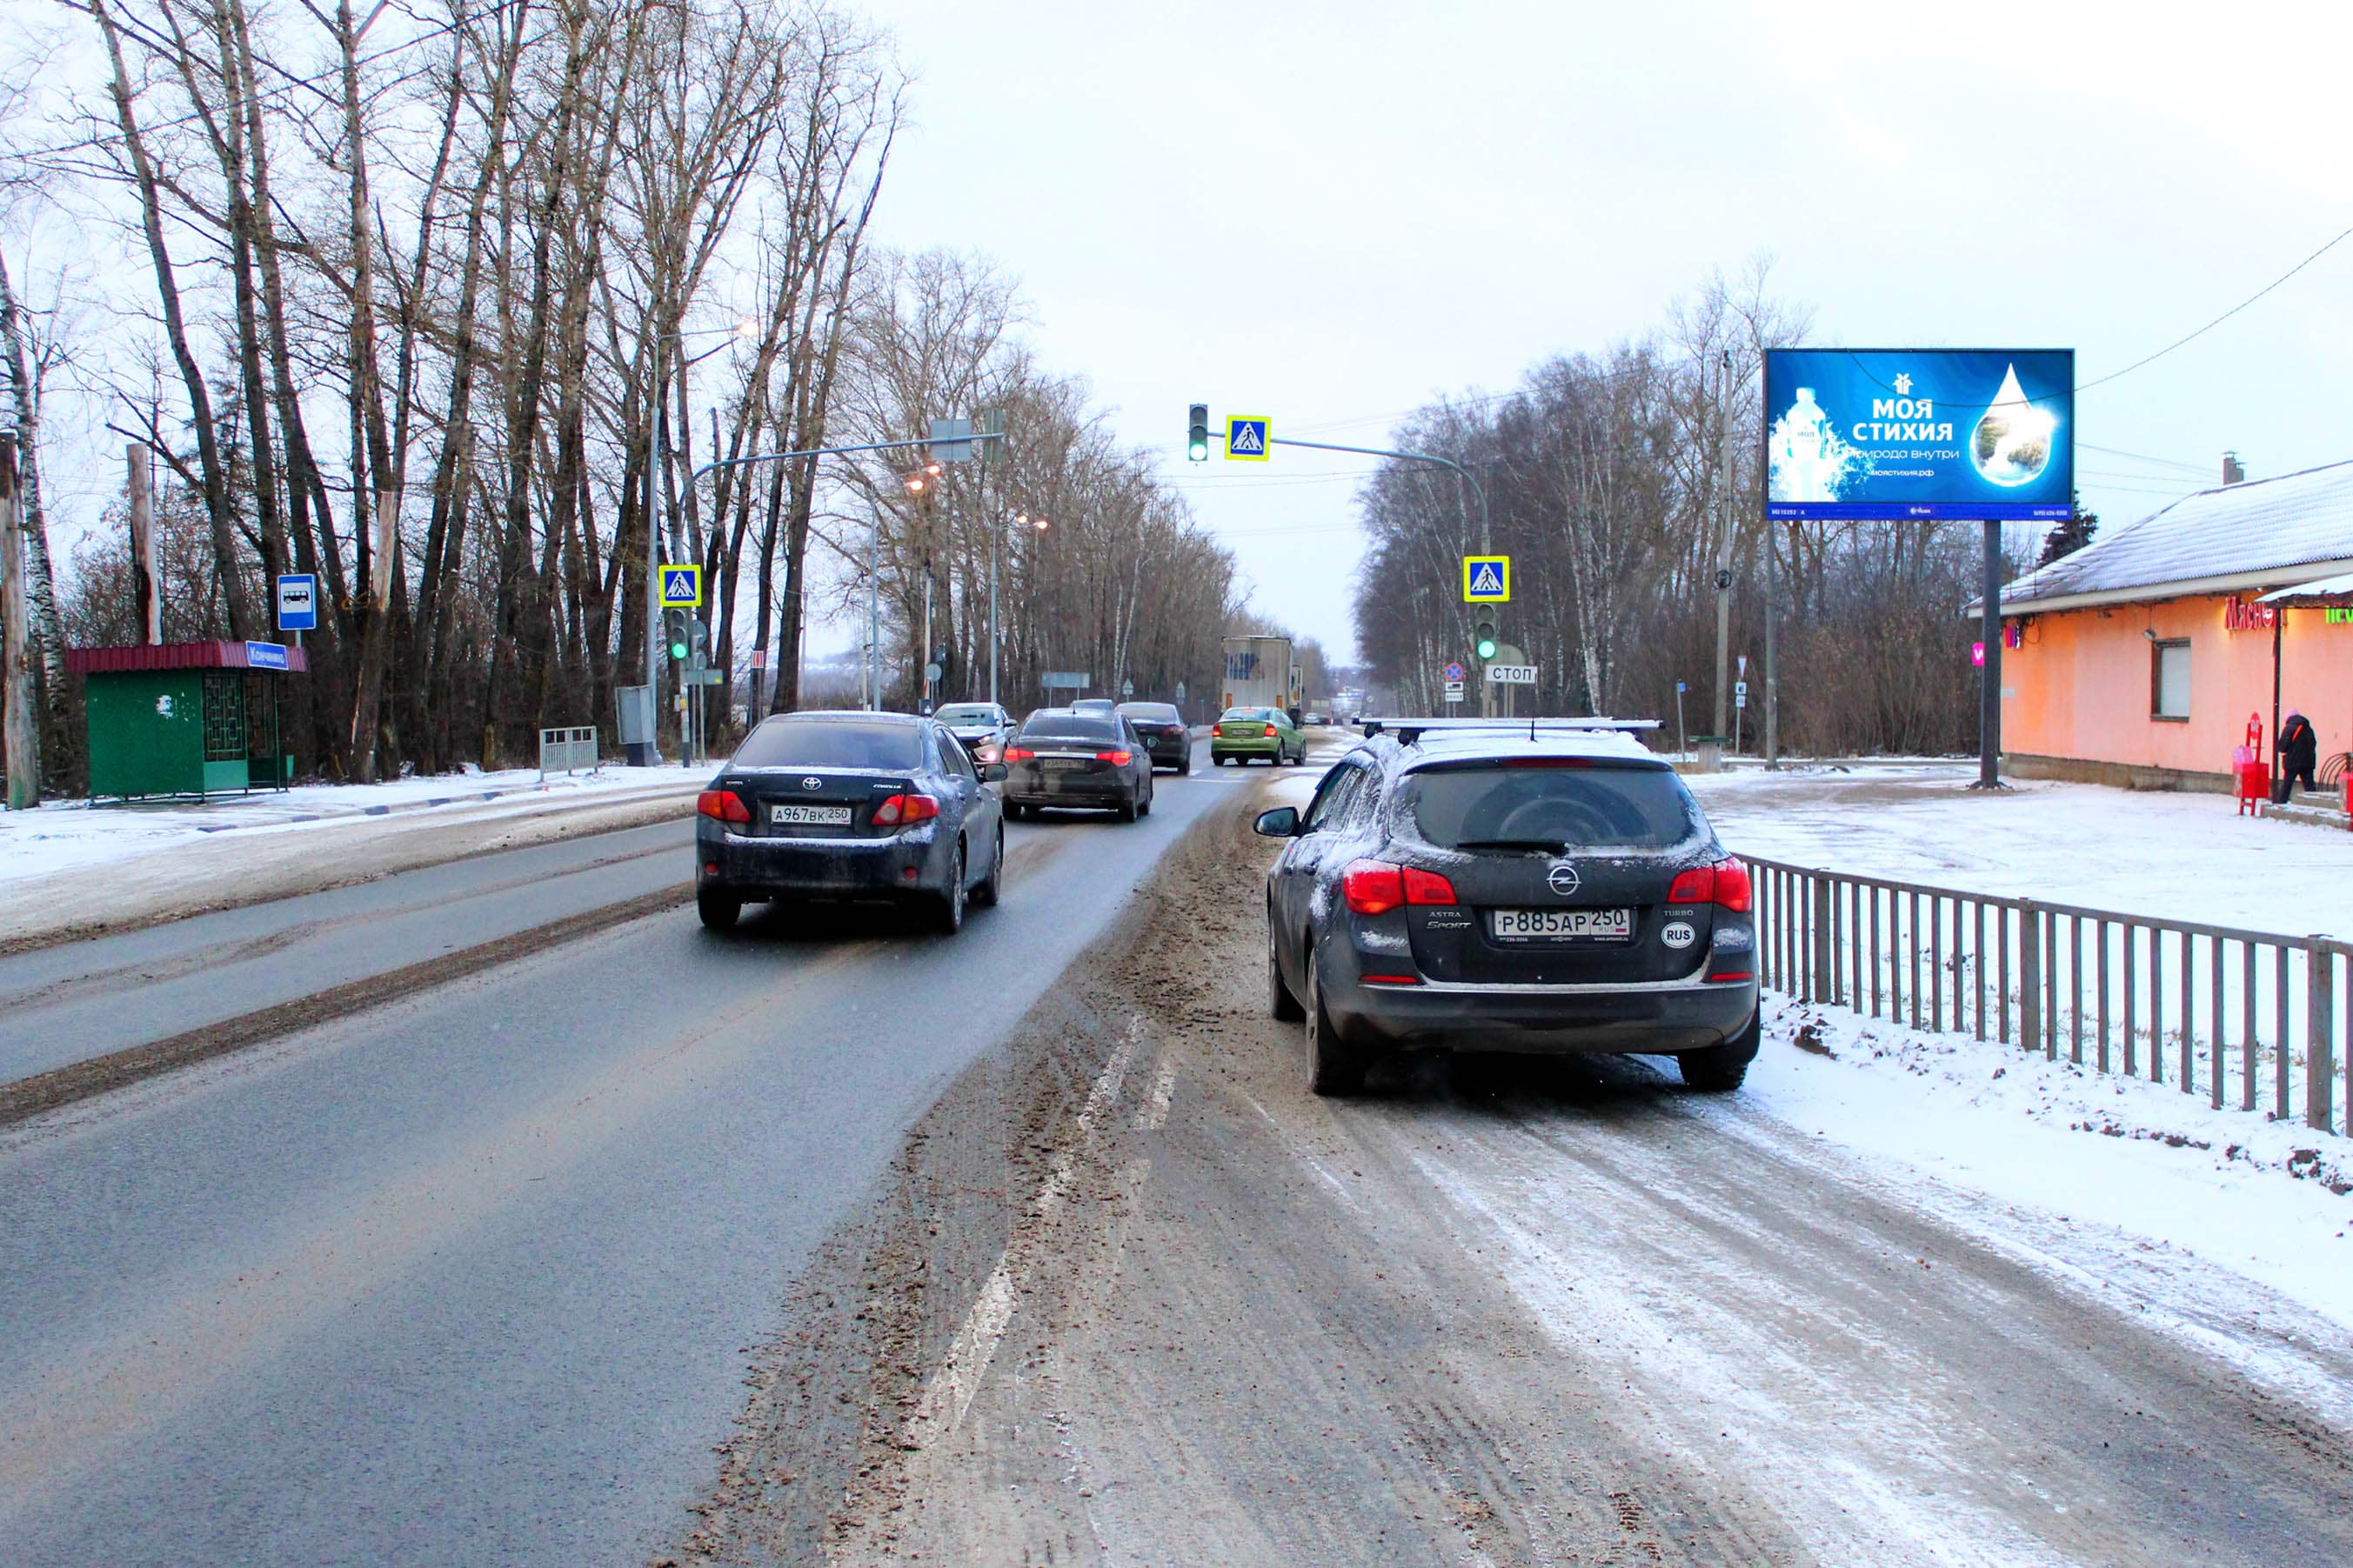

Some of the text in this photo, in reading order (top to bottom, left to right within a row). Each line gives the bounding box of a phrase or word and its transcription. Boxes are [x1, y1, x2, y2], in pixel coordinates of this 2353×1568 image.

[1872, 398, 1933, 419] МОЯ
[1853, 423, 1953, 441] СТИХИЯ
[1911, 450, 1960, 461] внутри
[1493, 667, 1532, 680] СТОП
[828, 808, 848, 818] 250
[1591, 910, 1624, 925] 250
[1667, 930, 1691, 940] RUS
